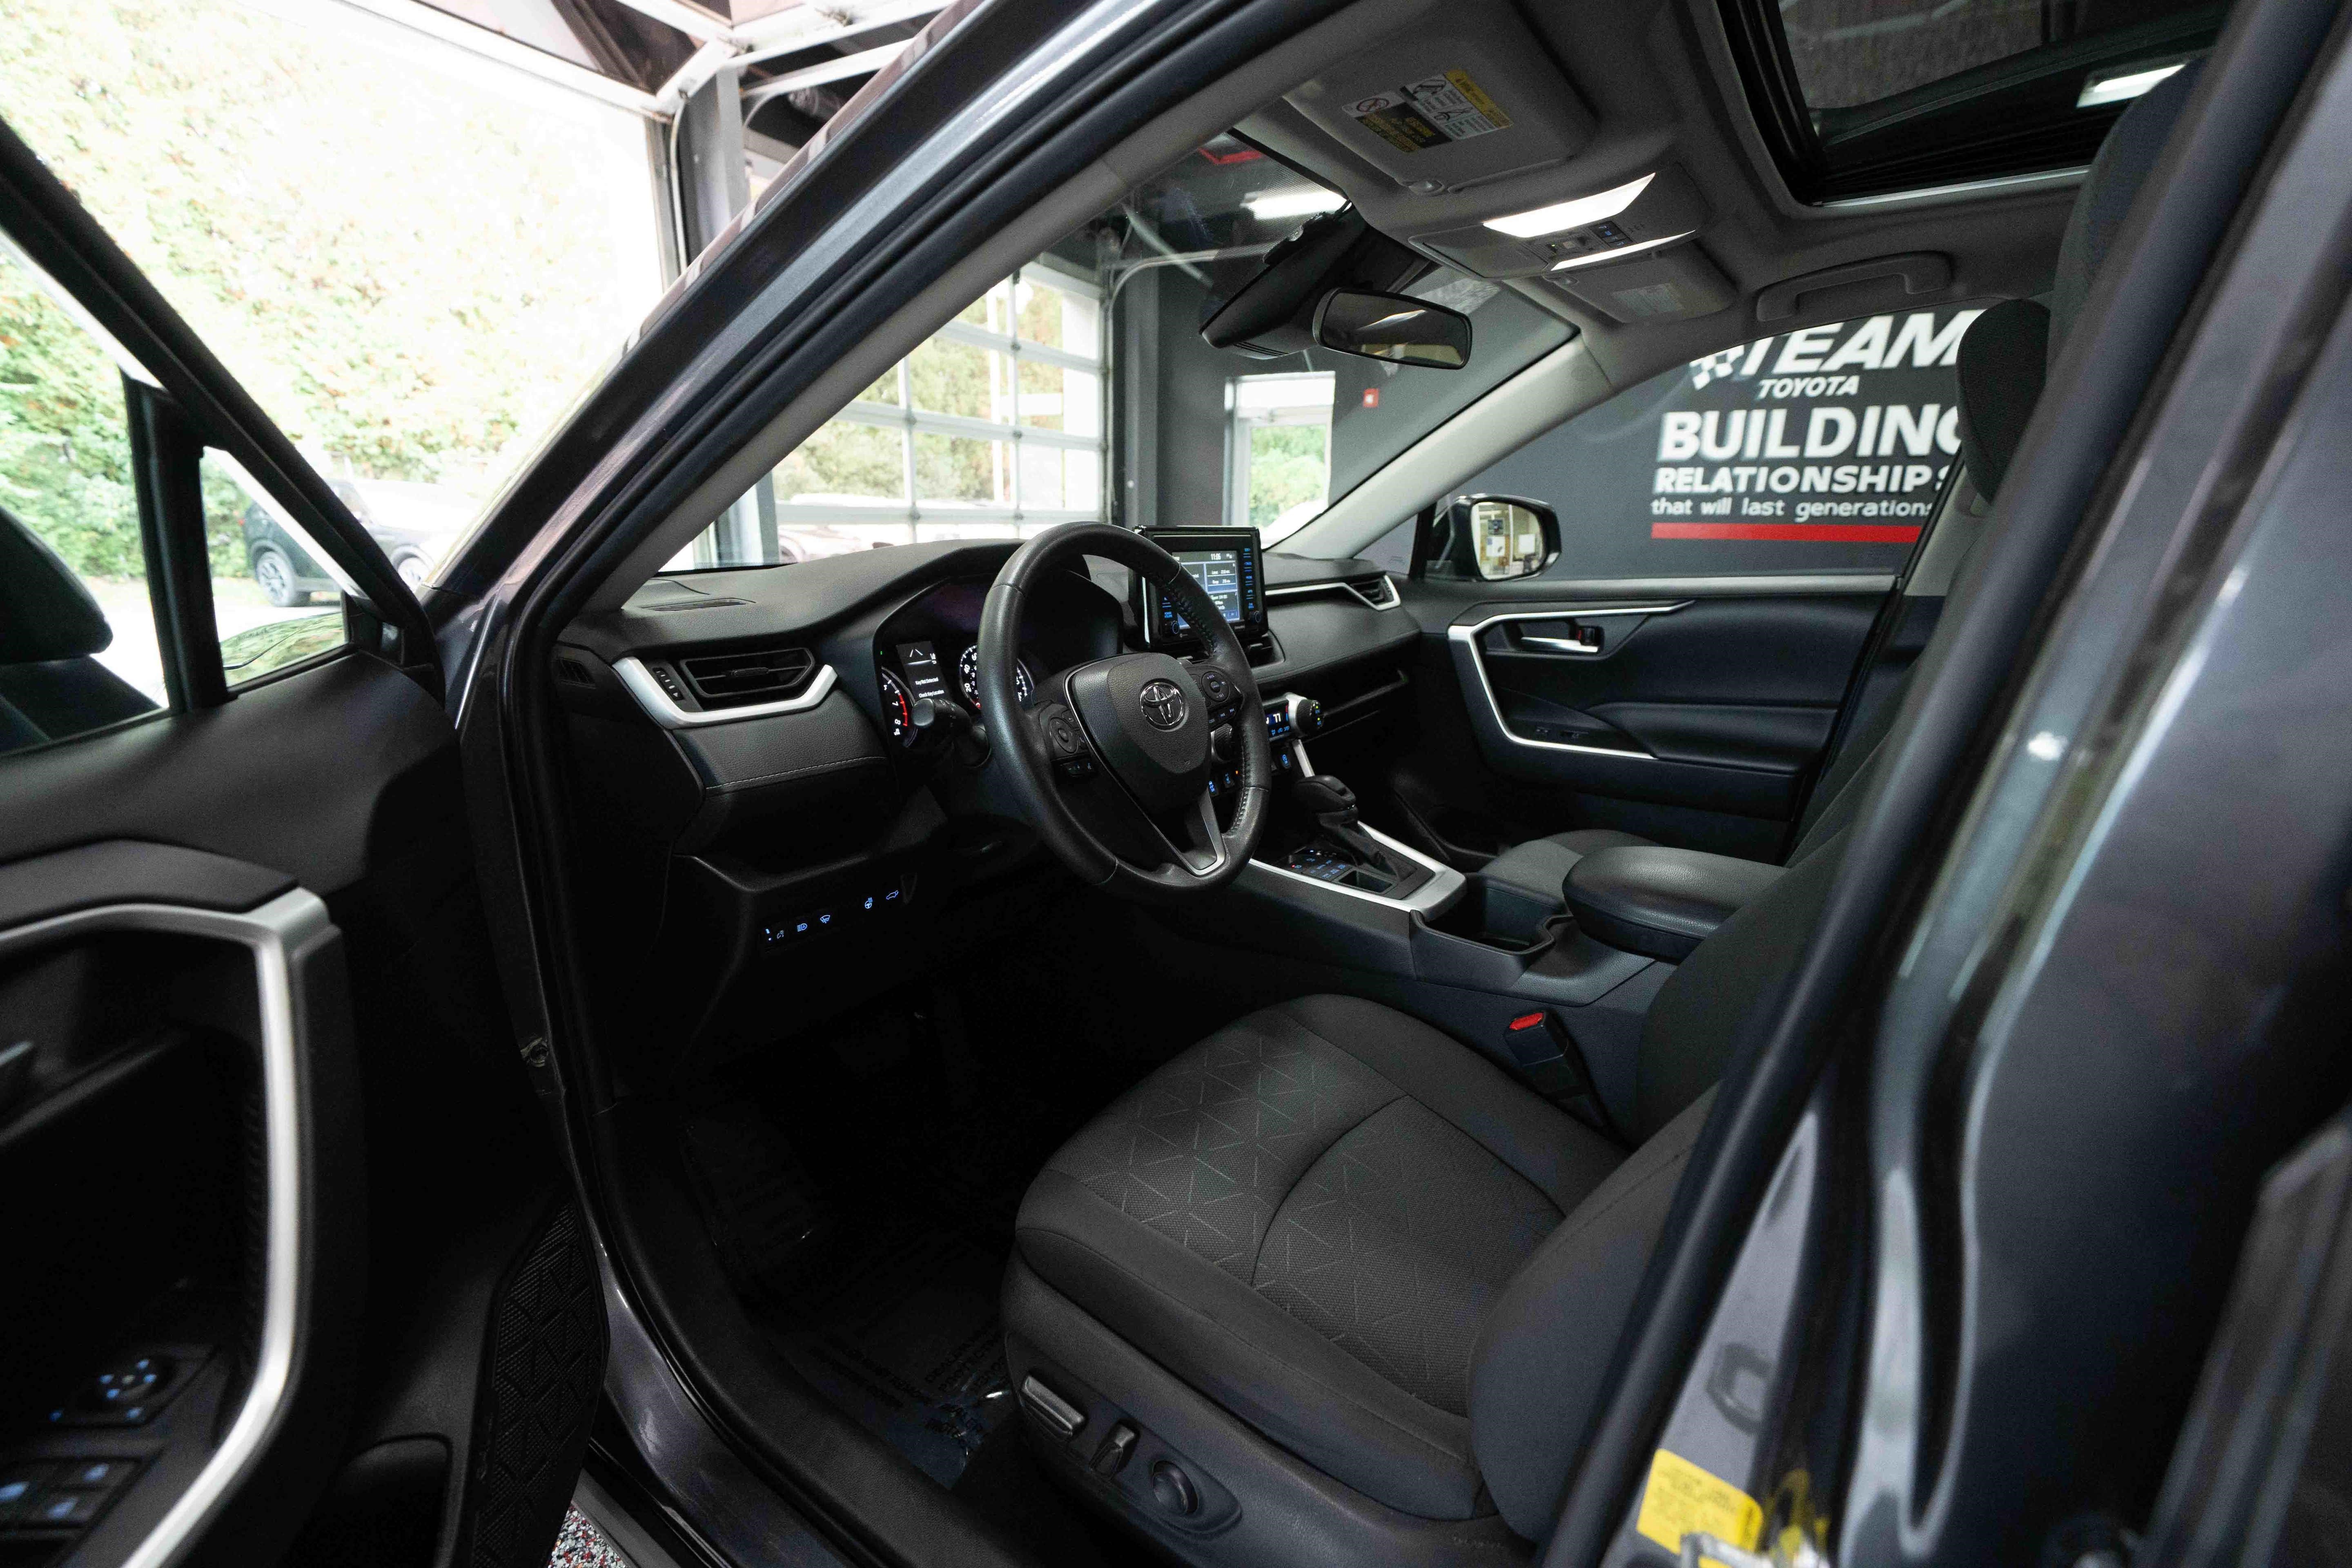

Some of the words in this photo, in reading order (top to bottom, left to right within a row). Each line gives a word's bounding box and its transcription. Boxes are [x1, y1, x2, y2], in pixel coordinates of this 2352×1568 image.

[1757, 375, 1860, 400] TOYOTA
[1650, 497, 1693, 515] that
[1701, 497, 1733, 515] will
[1741, 497, 1786, 516] last
